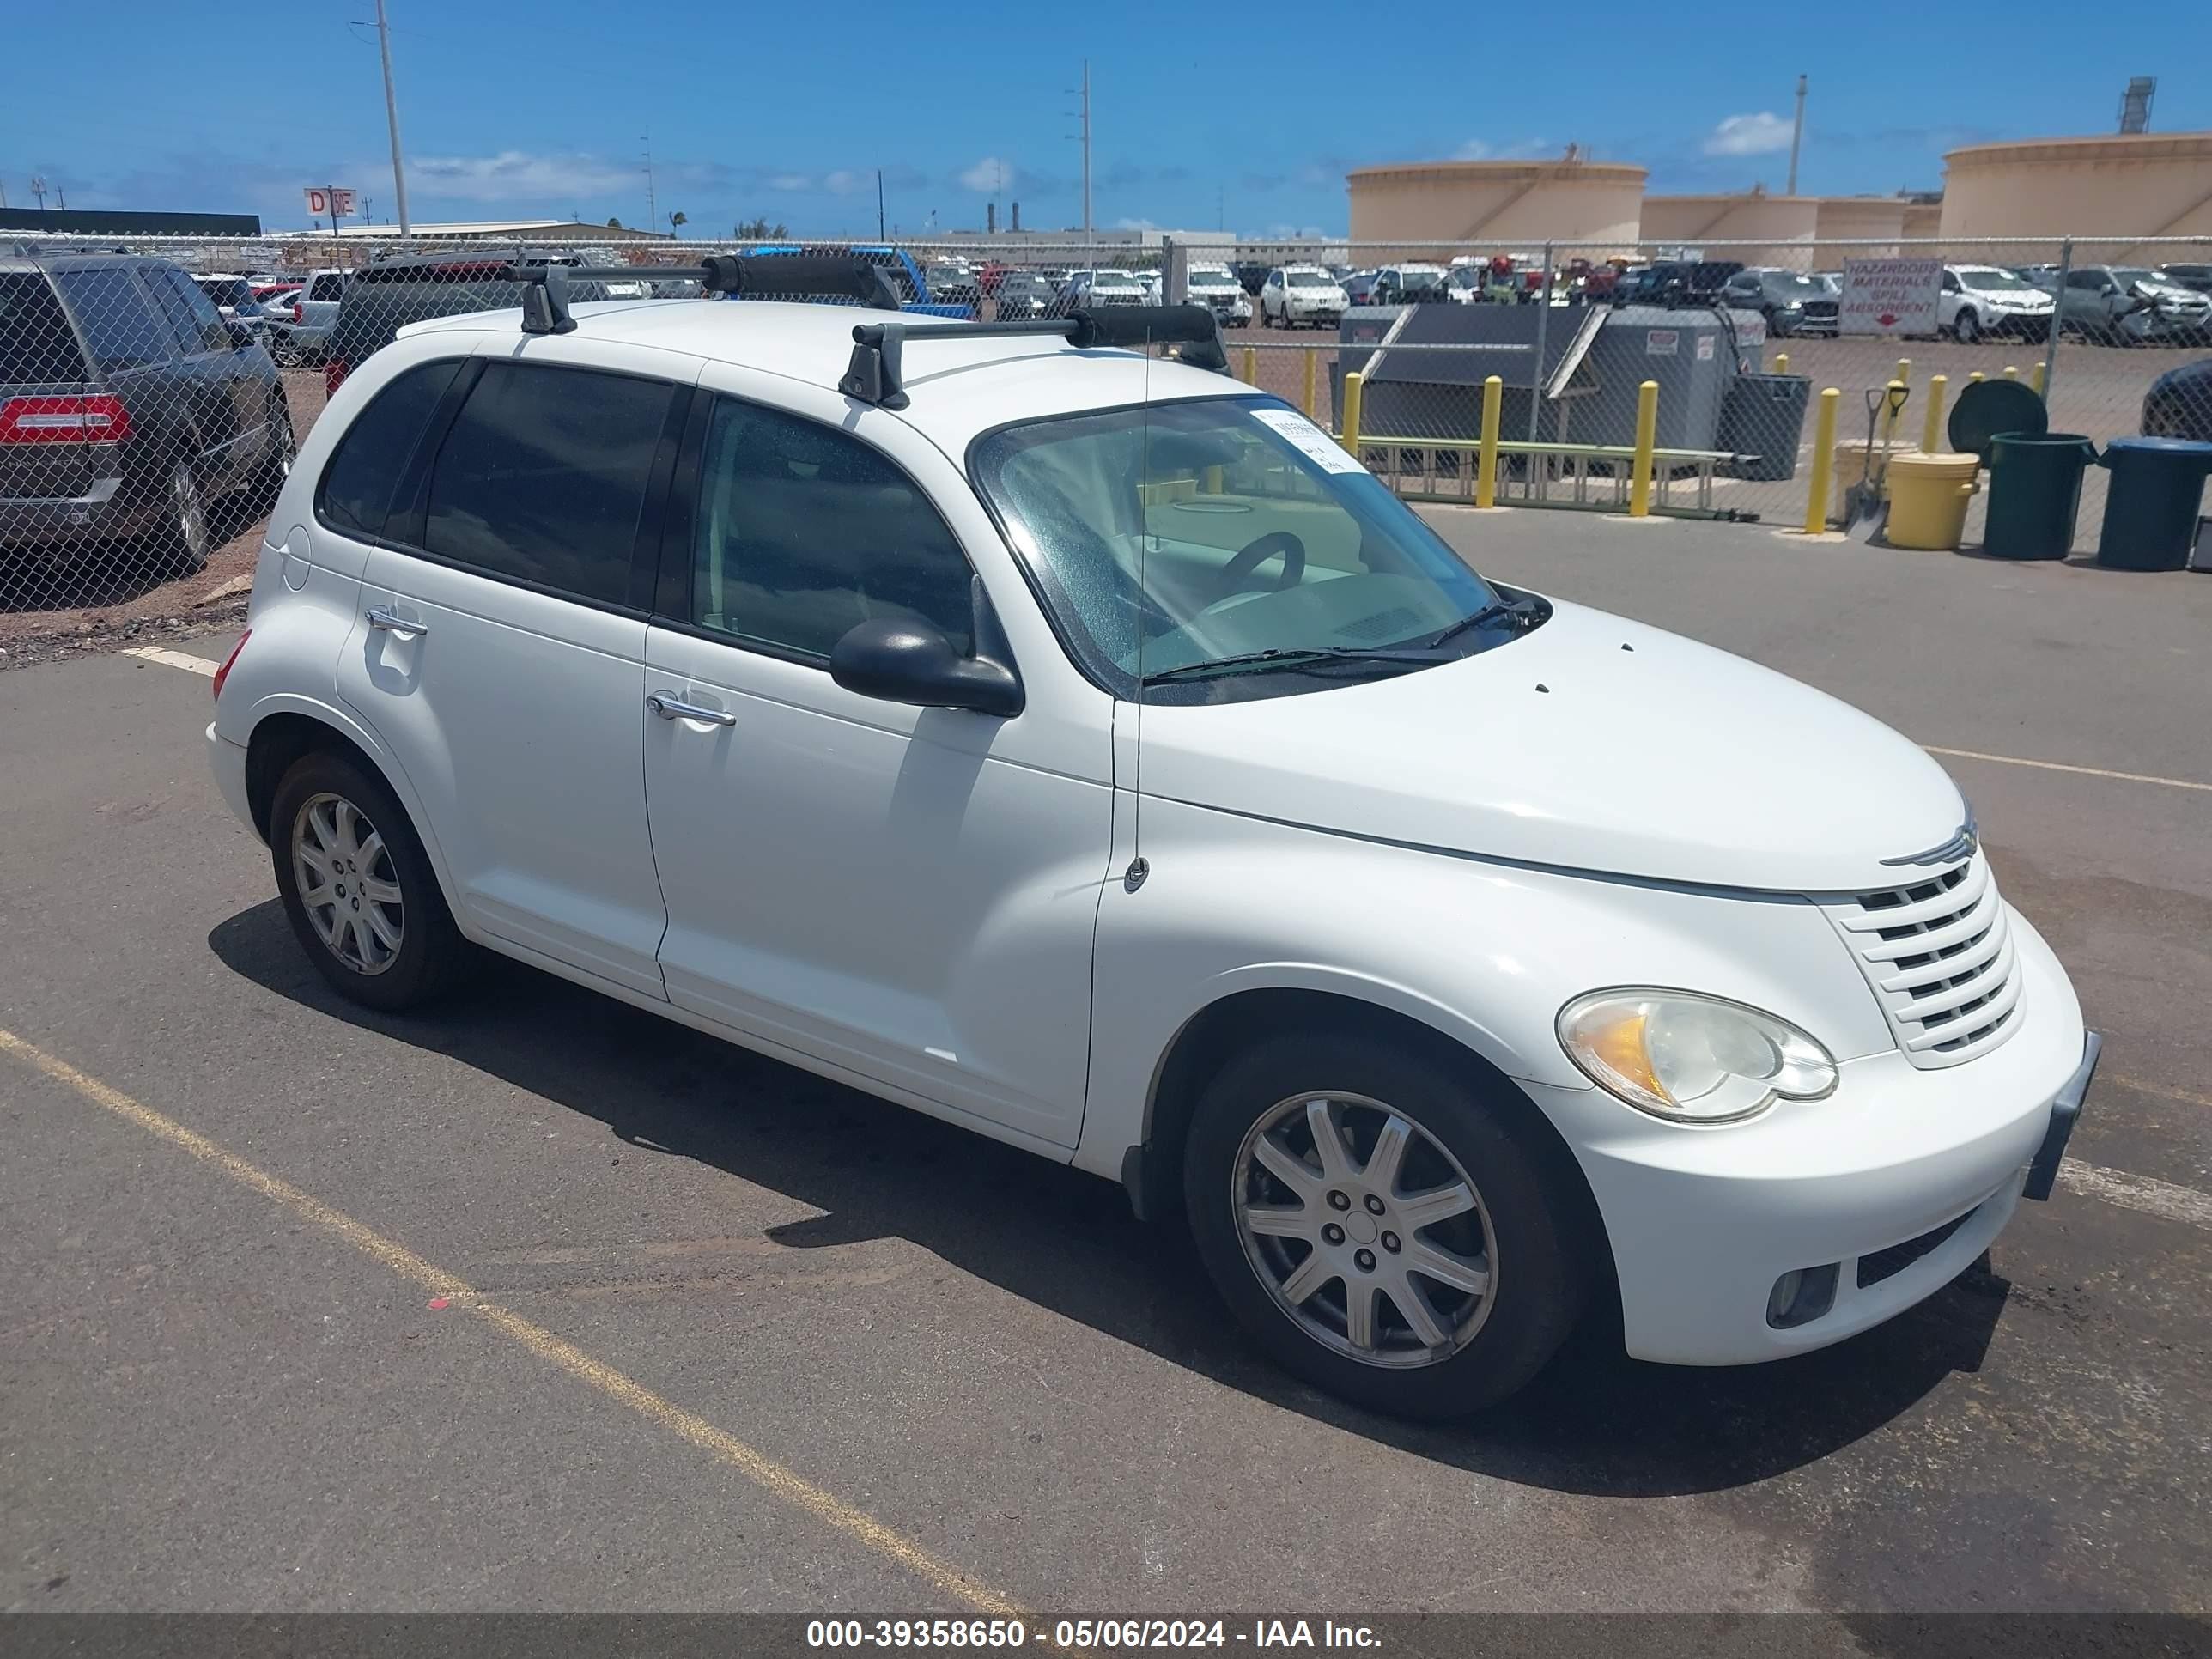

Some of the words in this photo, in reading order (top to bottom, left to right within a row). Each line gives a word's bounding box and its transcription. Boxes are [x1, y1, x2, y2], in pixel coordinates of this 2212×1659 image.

[1849, 263, 1939, 275] HAZARDOUS
[1852, 276, 1932, 288] MATERIALS
[1871, 289, 1910, 301] SPILL
[1845, 302, 1933, 313] ABSORBENT
